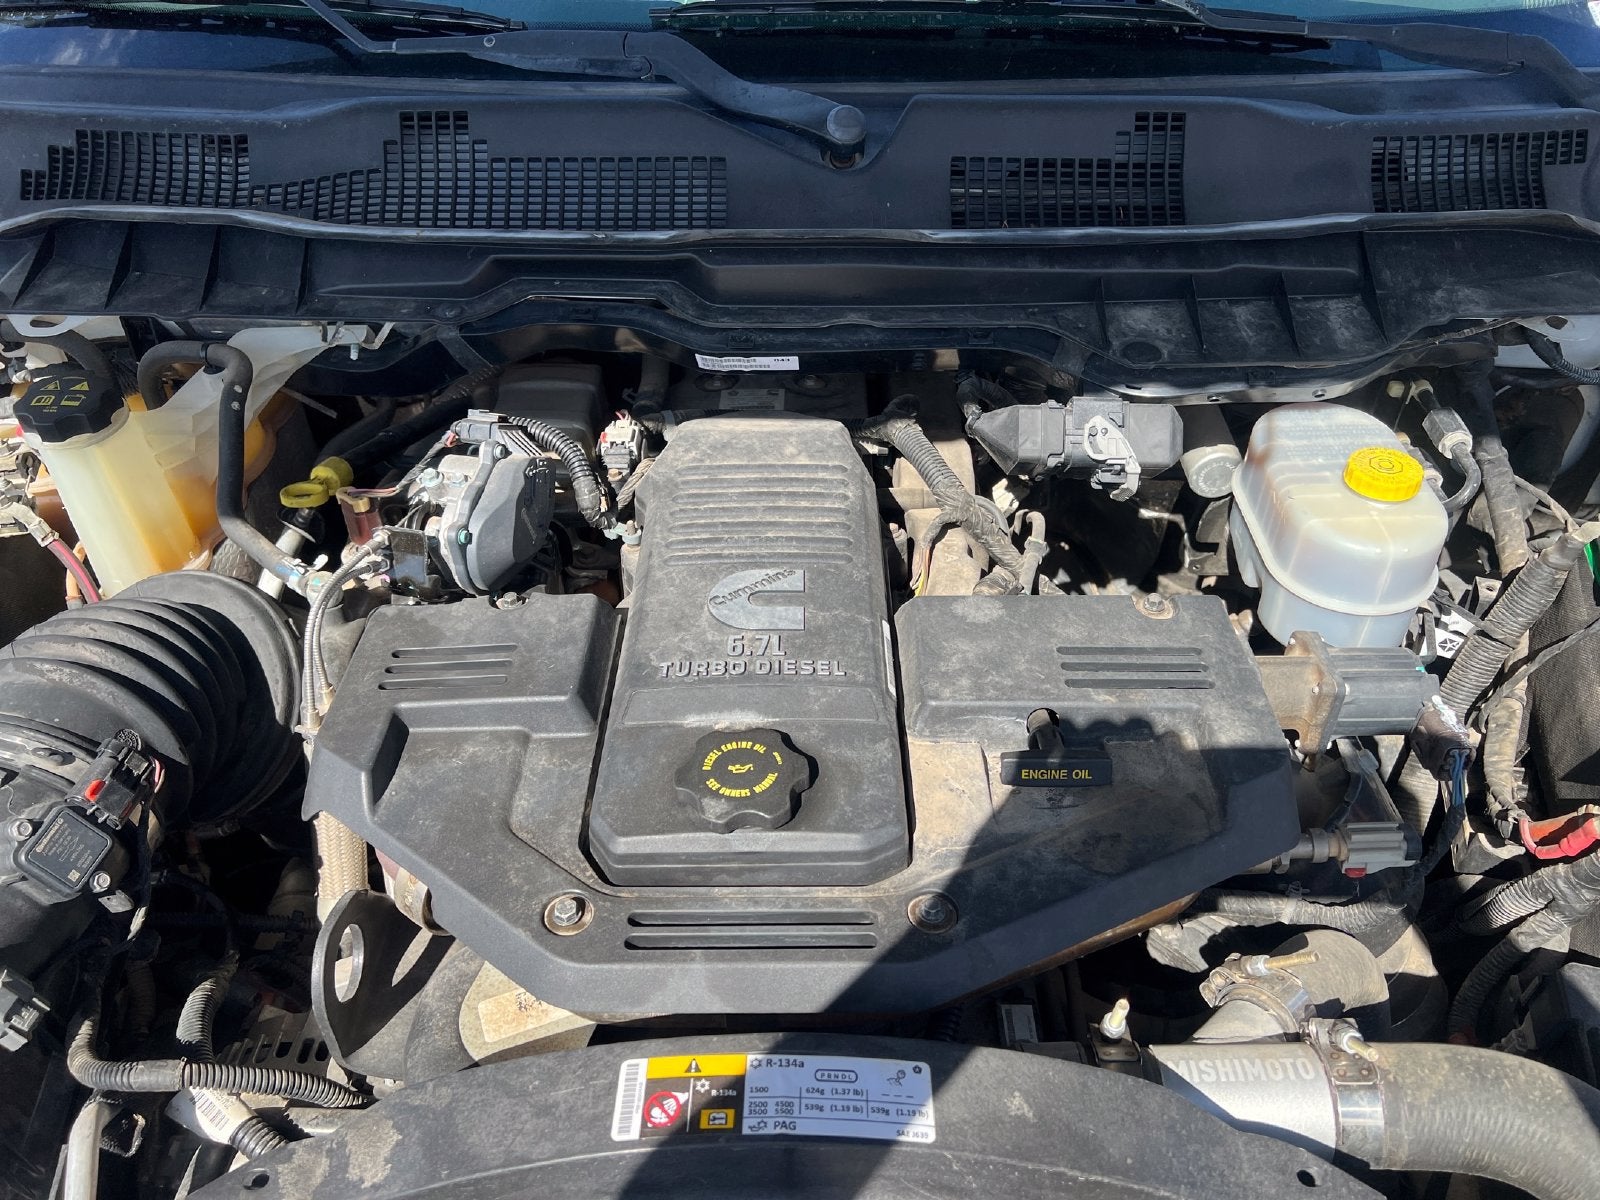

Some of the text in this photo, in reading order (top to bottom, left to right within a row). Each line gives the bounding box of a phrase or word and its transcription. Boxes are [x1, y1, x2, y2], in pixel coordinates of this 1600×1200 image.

[709, 568, 797, 606] Cummins
[727, 634, 787, 656] 6.7L
[659, 659, 848, 677] TURBO DIESEL
[702, 741, 767, 770] DIESEL ENGINE OIL
[1021, 769, 1093, 779] ENGINE OIL
[706, 778, 721, 791] SEE
[753, 772, 778, 793] MANUAL
[766, 1058, 805, 1069] R-134a
[1166, 1056, 1315, 1083] MISHIMOTO
[711, 1088, 737, 1098] R-134a
[749, 1086, 769, 1094] 1500
[805, 1087, 864, 1097] 624g (1.37 lb)
[748, 1108, 768, 1116] 3500
[804, 1103, 864, 1114] 539g (1.19 lb)
[870, 1106, 890, 1116] 539g
[773, 1121, 797, 1131] PAG
[896, 1129, 909, 1138] SAE
